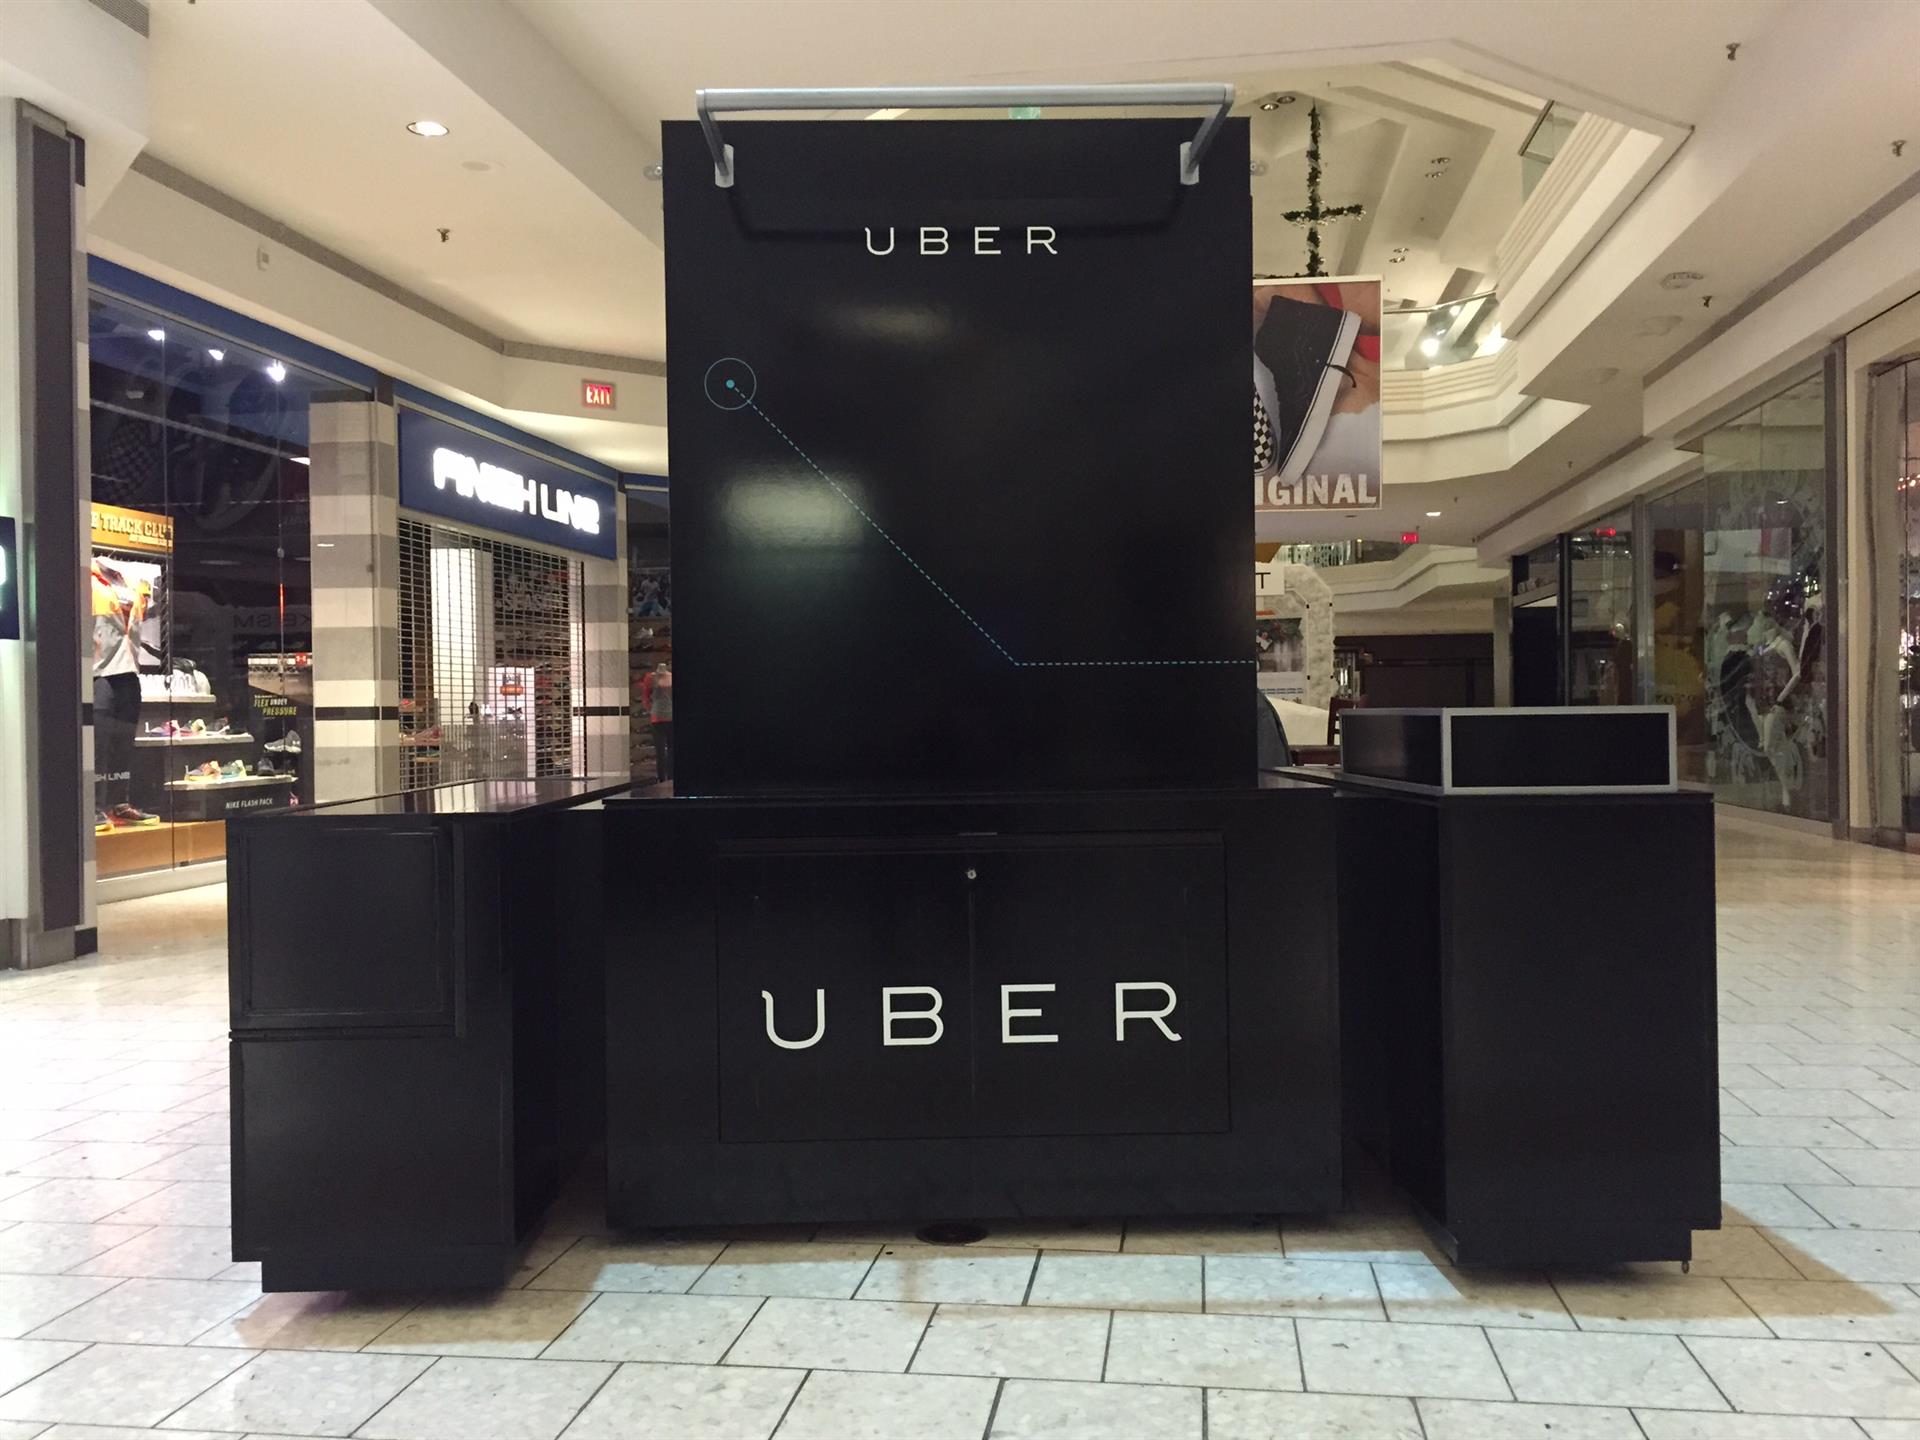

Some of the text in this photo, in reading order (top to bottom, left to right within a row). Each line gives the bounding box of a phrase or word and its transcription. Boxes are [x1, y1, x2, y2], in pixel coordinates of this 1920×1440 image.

[865, 227, 1058, 255] UBER
[586, 385, 611, 405] EXIT
[540, 483, 600, 534] LINE
[100, 513, 143, 535] TRACK
[225, 798, 273, 809] NIKE FLASH PACK
[762, 981, 1182, 1049] UBER
